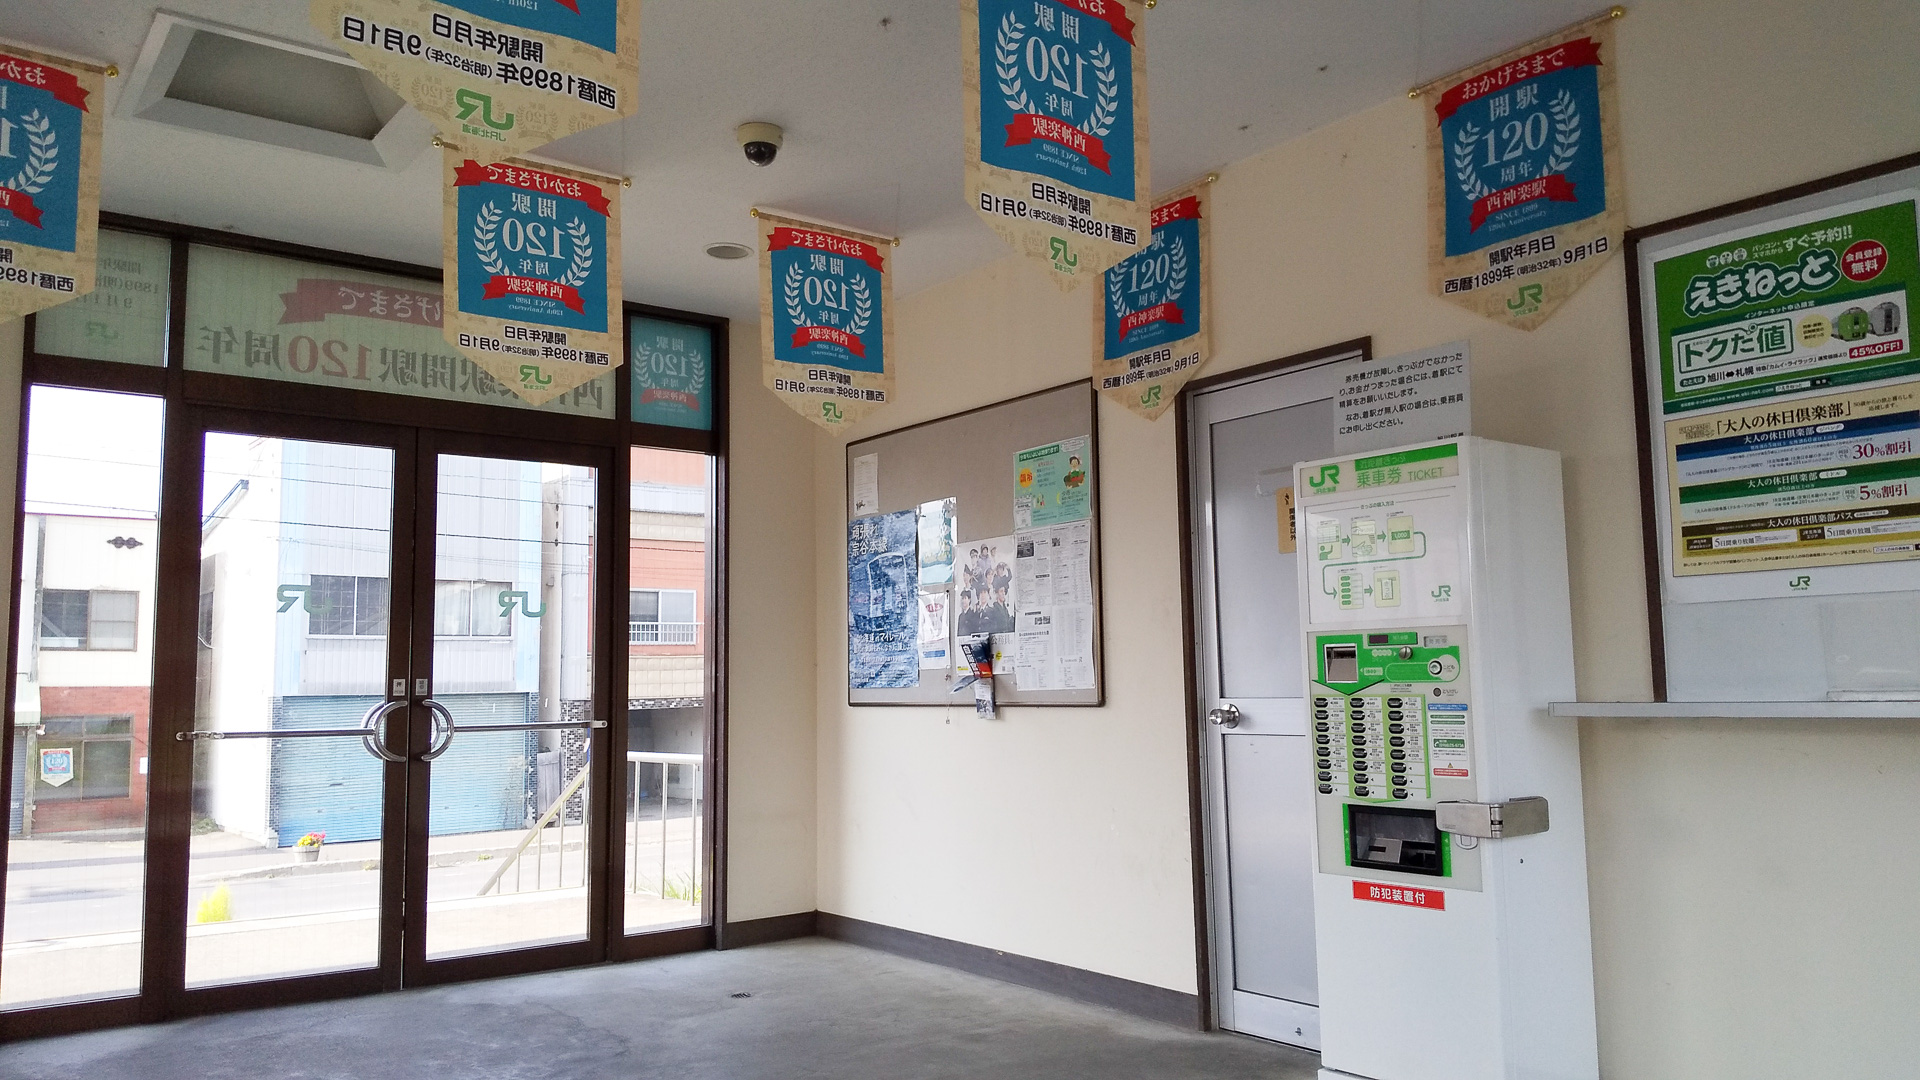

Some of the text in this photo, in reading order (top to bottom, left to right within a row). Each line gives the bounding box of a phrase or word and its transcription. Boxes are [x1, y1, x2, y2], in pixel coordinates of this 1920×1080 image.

[1461, 47, 1566, 99] おかげさまで
[1489, 83, 1539, 122] 開駅
[1481, 111, 1549, 168] 120
[1500, 159, 1533, 183] 周年
[1486, 179, 1547, 210] 西神楽駅
[1495, 209, 1520, 222] SINCE
[1135, 230, 1165, 259] 駅
[1489, 235, 1555, 267] 開駅年月日
[1845, 247, 1883, 263] 会員登録
[1127, 253, 1170, 294] 120
[1851, 258, 1879, 275] 無料
[1688, 253, 1835, 312] えきねっと
[1138, 291, 1158, 307] 周年
[1506, 283, 1544, 310] JR
[1128, 305, 1165, 327] 西神楽駅
[1684, 325, 1787, 368] トクだ値
[1851, 341, 1901, 357] 45%OFF!
[1707, 371, 1725, 383] 旭川
[1735, 366, 1754, 378] 札幌
[1140, 385, 1162, 405] JR
[1339, 418, 1404, 435] にお申し出ください。
[1716, 400, 1852, 436] 「大人の休日倶楽部」
[1743, 426, 1815, 444] 大人の休日倶楽部
[1852, 440, 1912, 460] 30%割引
[1309, 464, 1340, 488] JR
[1356, 466, 1444, 489] 乗車券 TICKET
[1747, 472, 1818, 489] 大人の休日倶楽部
[1859, 483, 1908, 501] 5%割引
[1767, 512, 1853, 528] 大人の休日倶楽部パス
[1430, 584, 1452, 599] JR
[1789, 575, 1811, 587] JR
[1369, 885, 1426, 906] 防犯装置付
